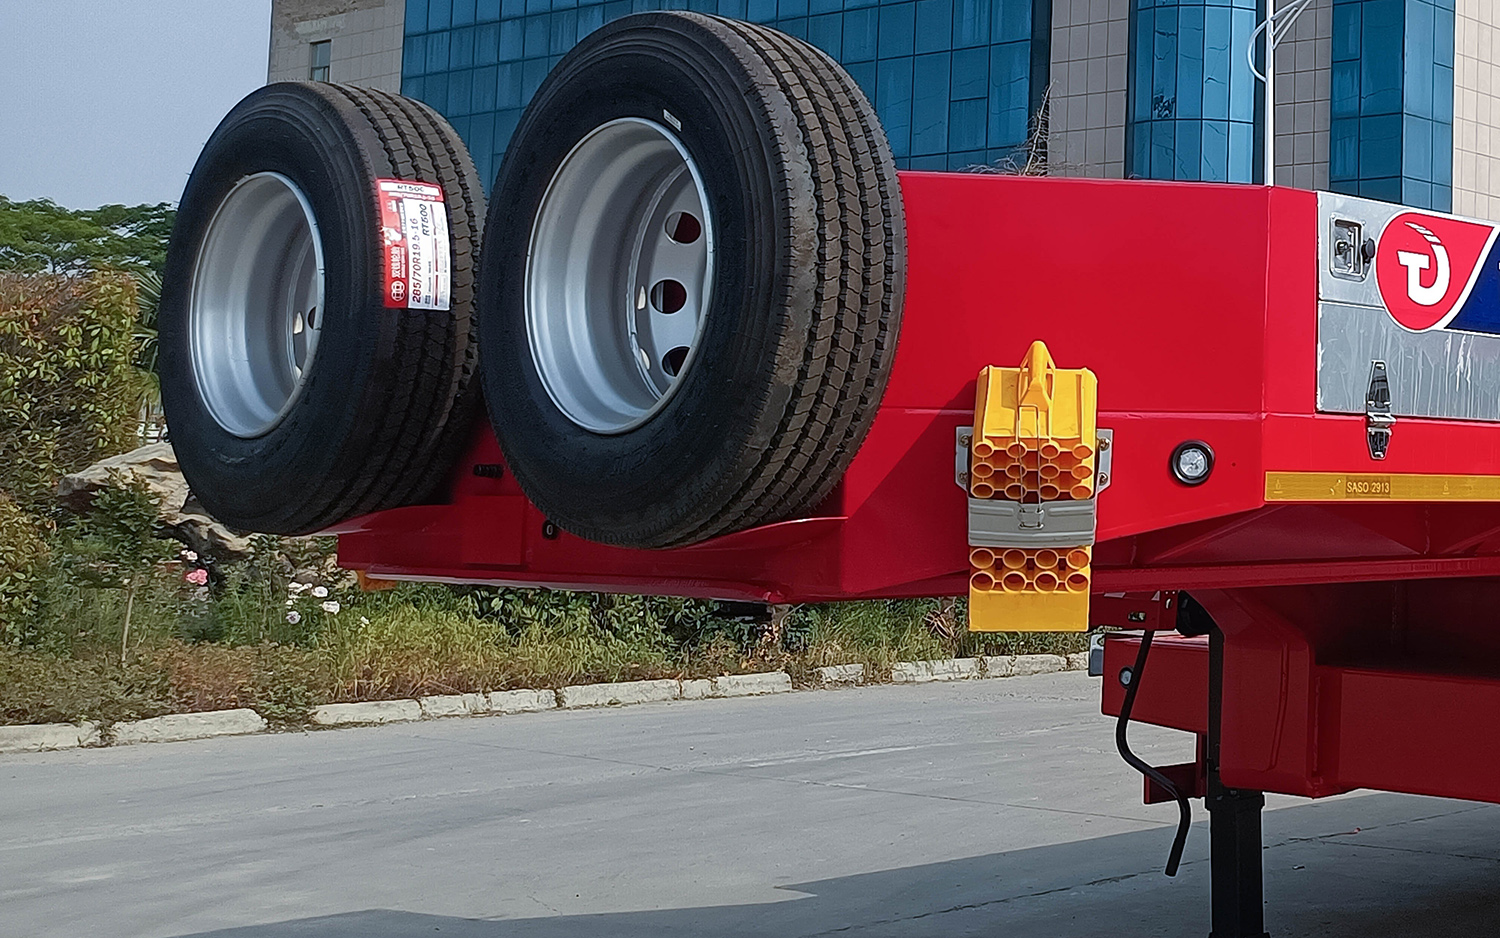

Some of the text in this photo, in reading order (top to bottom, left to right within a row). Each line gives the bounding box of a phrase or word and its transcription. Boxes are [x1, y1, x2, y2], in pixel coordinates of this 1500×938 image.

[419, 204, 430, 236] RT500
[1346, 482, 1390, 494] SASO 2913
